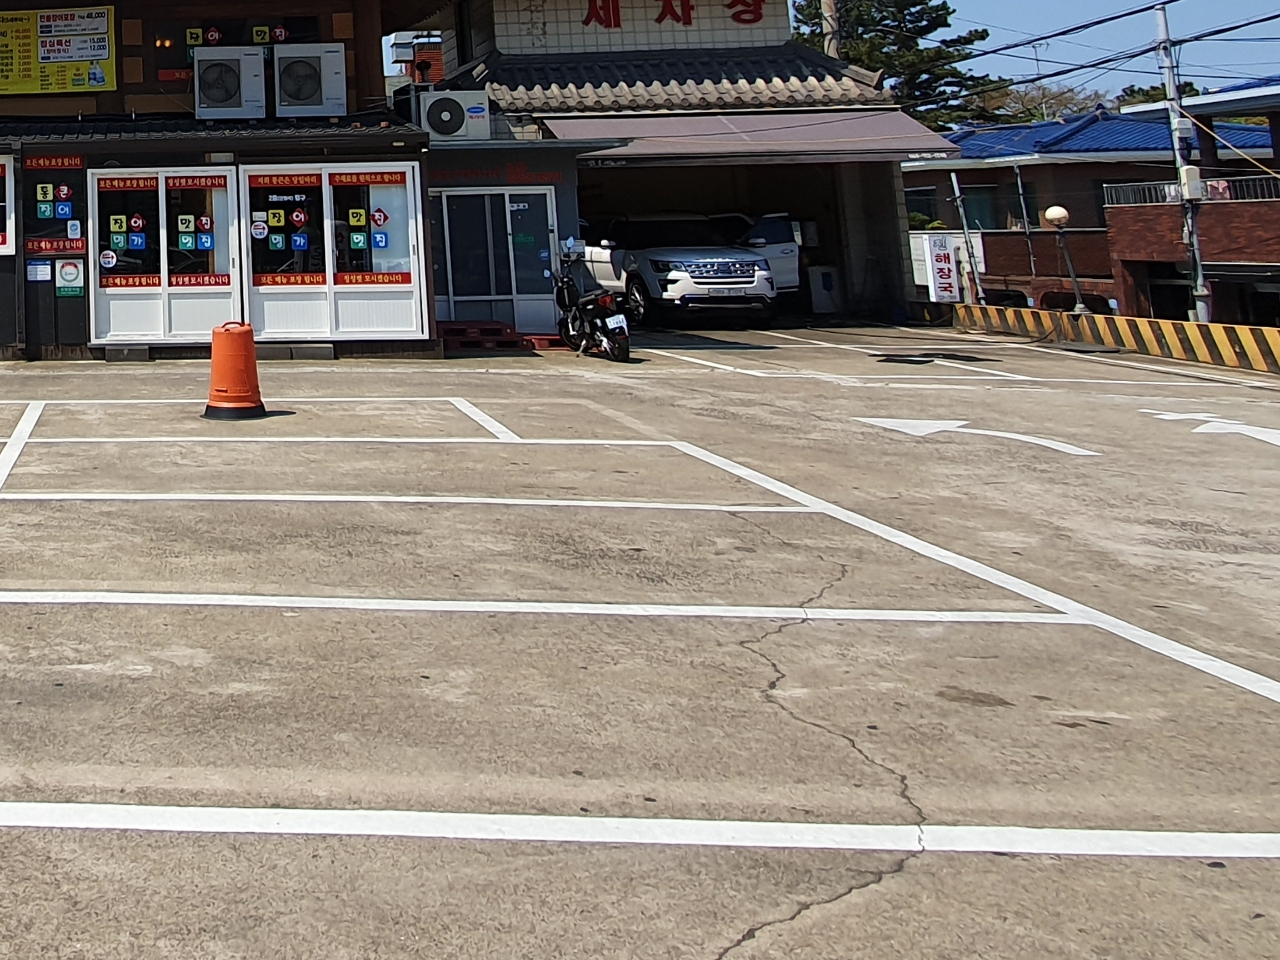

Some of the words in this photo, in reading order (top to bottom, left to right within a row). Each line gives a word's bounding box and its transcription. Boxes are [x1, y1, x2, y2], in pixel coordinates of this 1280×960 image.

[40, 38, 72, 48] 점심특선
[25, 157, 37, 167] 모든
[37, 157, 50, 167] 메뉴
[51, 157, 63, 167] 포장
[63, 156, 81, 167] 됩니다
[99, 178, 112, 189] 모든
[113, 178, 125, 189] 메뉴
[126, 178, 139, 189] 포장
[140, 178, 158, 188] 됩니다
[167, 177, 187, 188] 정성껏
[187, 176, 226, 187] 모시겠습니다
[383, 173, 402, 183] 합니다
[27, 240, 40, 250] 모든
[40, 240, 52, 250] 메뉴
[53, 240, 64, 250] 포장
[65, 239, 83, 250] 됩니다
[260, 274, 273, 285] 모든
[275, 274, 288, 285] 메뉴
[290, 274, 303, 285] 포장
[304, 273, 323, 284] 됩니다
[343, 273, 363, 285] 정성껏
[364, 272, 403, 284] 모시겠습니다
[934, 252, 955, 294] 해장국
[101, 276, 114, 287] 모든
[115, 275, 127, 287] 메뉴
[127, 275, 140, 287] 포장
[141, 275, 160, 286] 됩니다
[170, 275, 190, 287] 정성껏
[190, 274, 229, 286] 모시겠습니다
